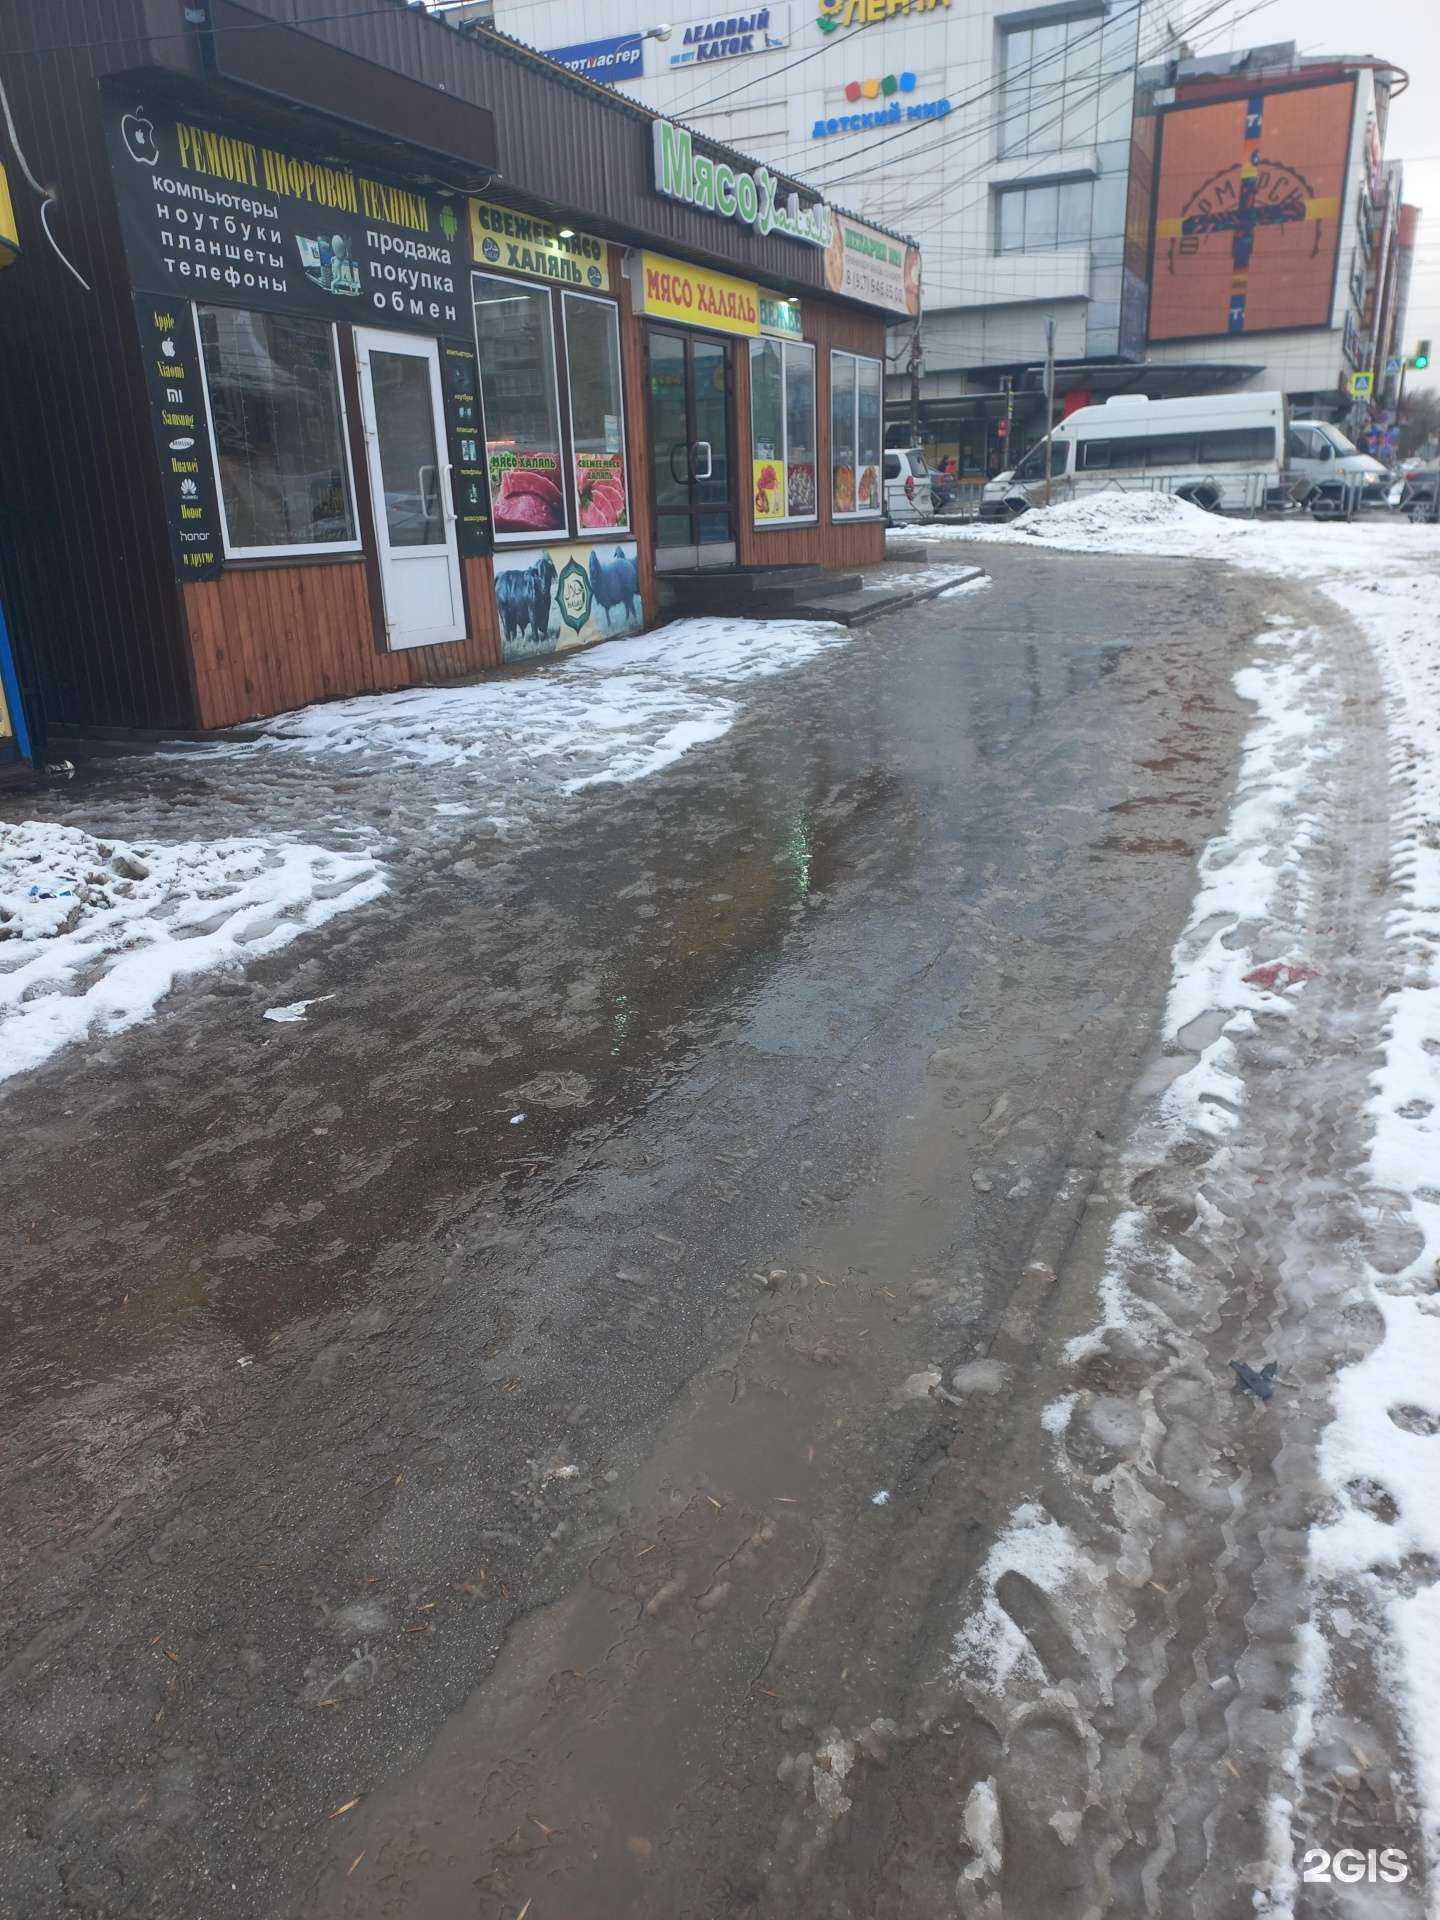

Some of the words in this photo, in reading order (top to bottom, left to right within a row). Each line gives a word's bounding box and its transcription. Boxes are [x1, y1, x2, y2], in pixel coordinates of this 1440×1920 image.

[683, 8, 769, 44] ЛЕДОВЫЙ
[697, 34, 753, 61] КАТОК
[176, 121, 257, 187] РЕМОНТ
[262, 148, 358, 214] ЦИФРОВОЙ
[359, 178, 429, 233] ТЕХНИКИ
[152, 175, 279, 219] компьютеры
[157, 202, 282, 244] ноутбуки
[479, 205, 554, 249] СВЕЖЕЕ
[161, 230, 284, 269] планшеты
[367, 229, 451, 265] продажа
[507, 242, 583, 284] ХАЛЯЛЬ
[164, 257, 287, 293] телефоны
[369, 260, 454, 293] покупка
[373, 291, 457, 321] обмен
[646, 268, 693, 309] МЯСО
[697, 283, 756, 324] ХАЛЯЛЬ
[154, 311, 175, 332] Apple
[157, 361, 185, 379] Xiaomi
[162, 410, 194, 429] Samsung
[171, 457, 199, 472] Huawei
[490, 456, 517, 468] МЯСО
[519, 458, 556, 469] ХАЛЯЛЬ
[181, 504, 203, 519] Honor
[180, 531, 209, 541] honor
